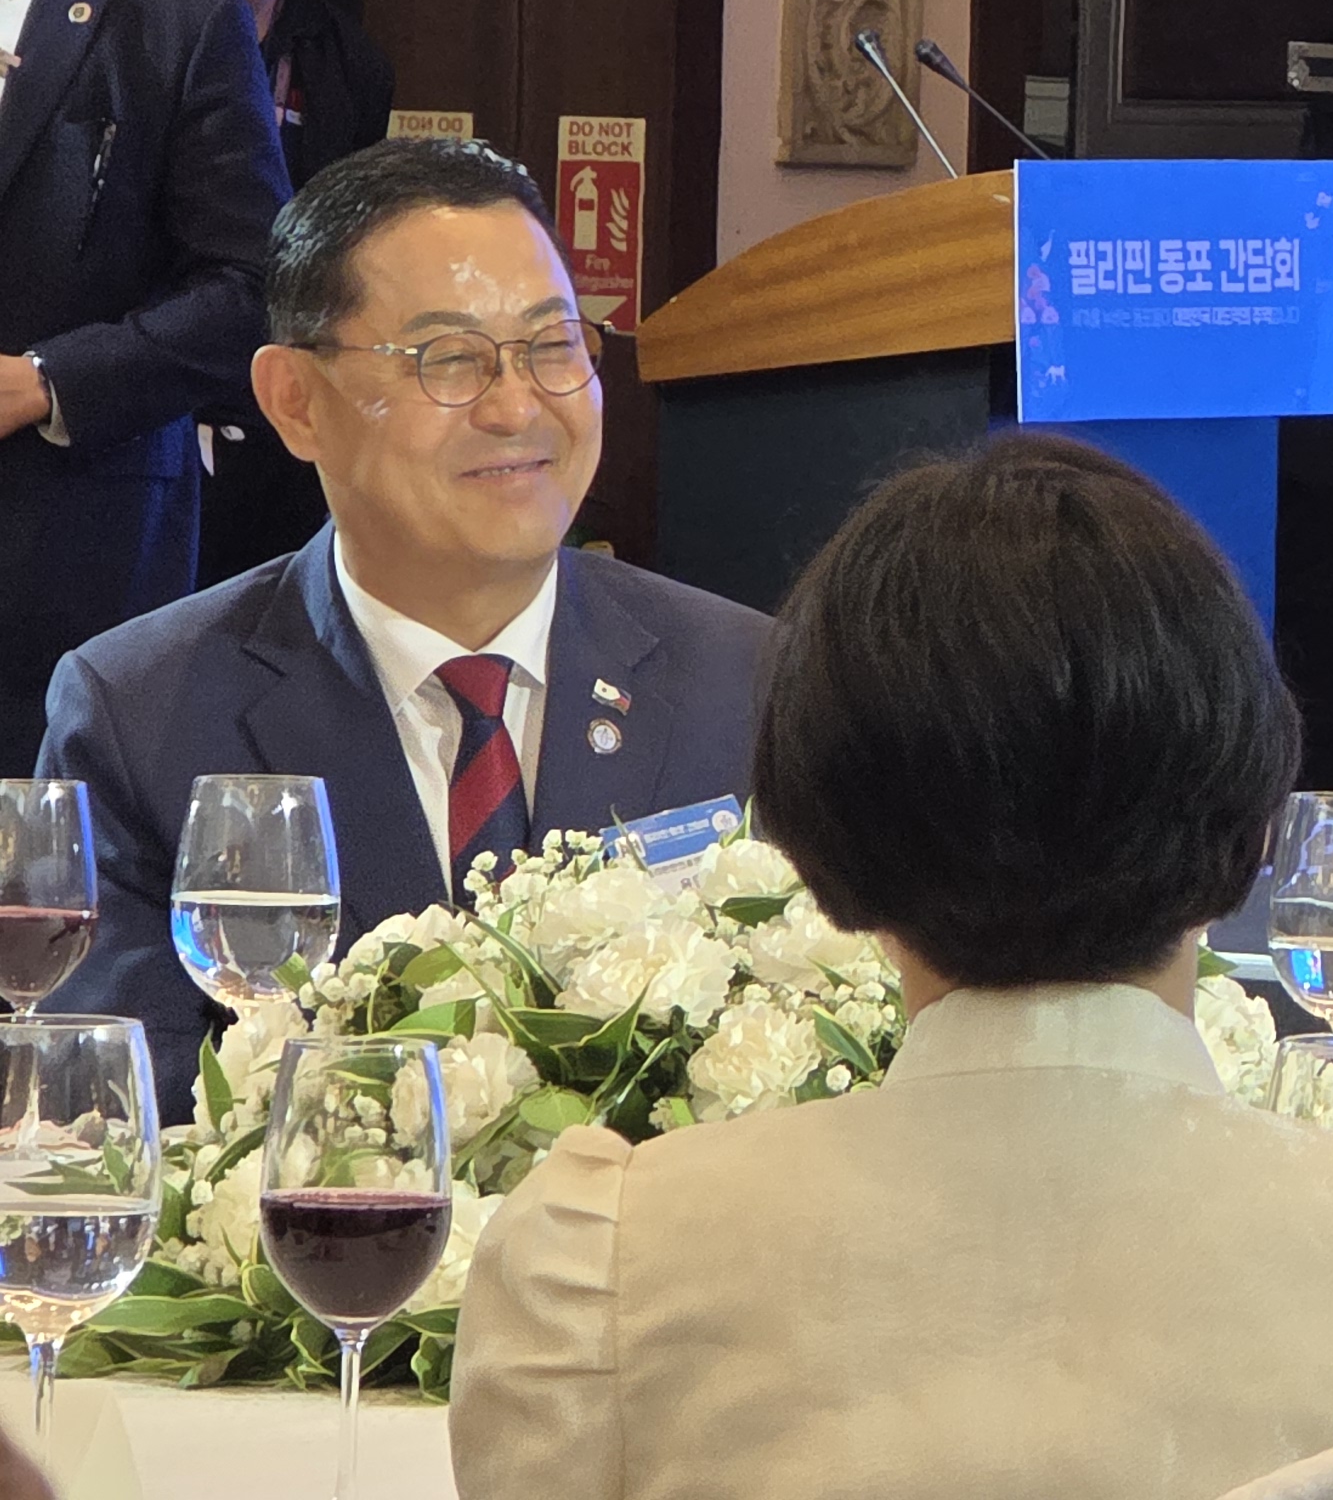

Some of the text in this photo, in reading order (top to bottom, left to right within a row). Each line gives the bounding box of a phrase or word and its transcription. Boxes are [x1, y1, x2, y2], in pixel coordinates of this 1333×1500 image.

[568, 121, 634, 138] DO NOT
[567, 140, 633, 157] BLOCK
[1068, 237, 1300, 295] 필리핀 동포 간담회
